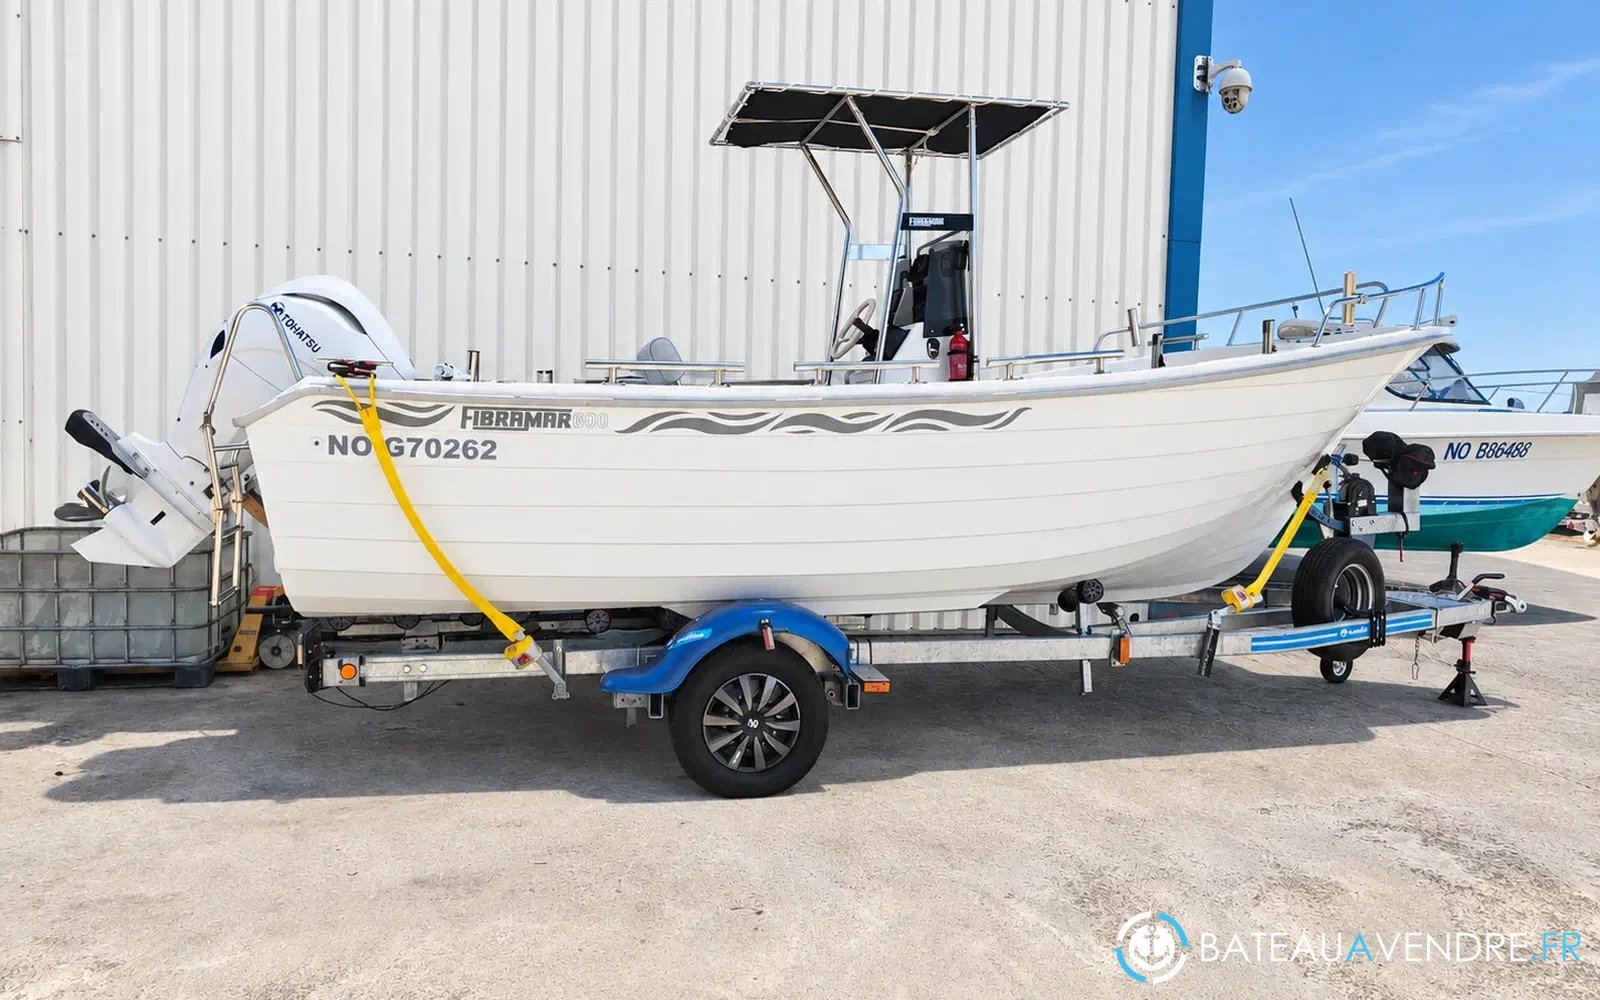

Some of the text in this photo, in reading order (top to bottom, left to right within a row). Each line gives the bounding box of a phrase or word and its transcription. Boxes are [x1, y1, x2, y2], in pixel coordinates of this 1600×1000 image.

[281, 314, 321, 353] TOHATSU
[328, 435, 497, 460] NO G70262
[1443, 442, 1532, 460] NO B86488
